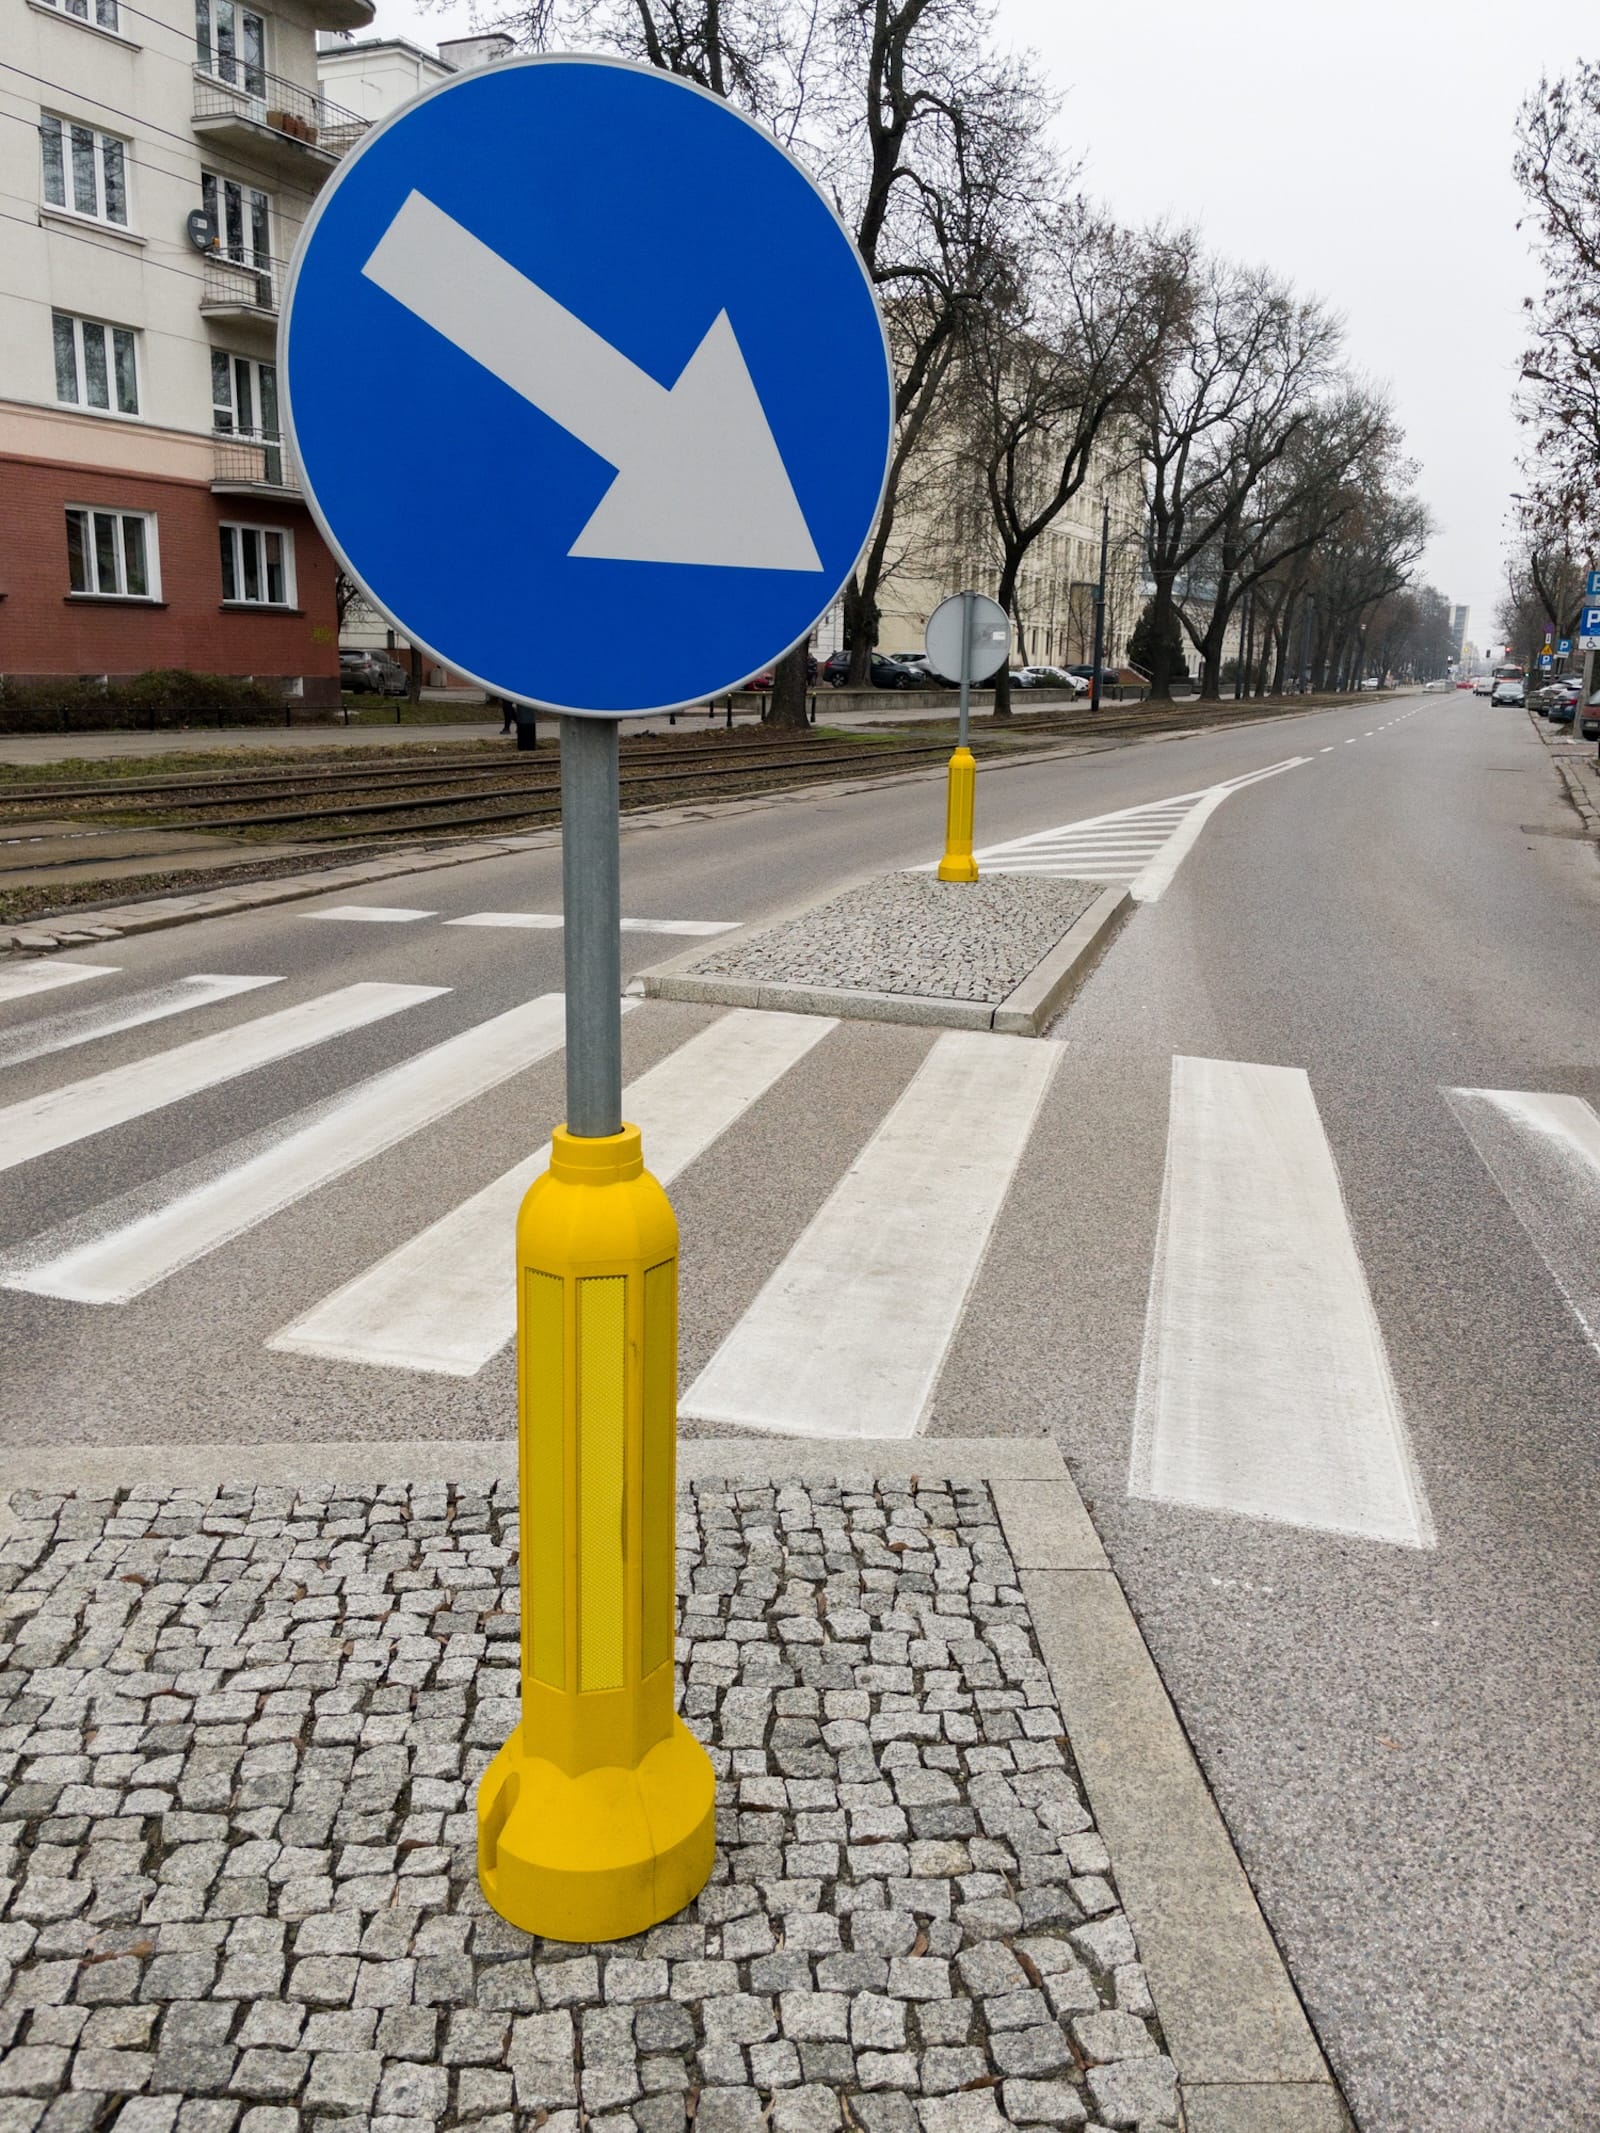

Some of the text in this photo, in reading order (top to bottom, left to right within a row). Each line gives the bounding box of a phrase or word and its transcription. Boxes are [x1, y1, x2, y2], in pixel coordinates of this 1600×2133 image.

[1586, 610, 1600, 628] P
[1560, 641, 1569, 651] P
[1542, 655, 1550, 665] P
